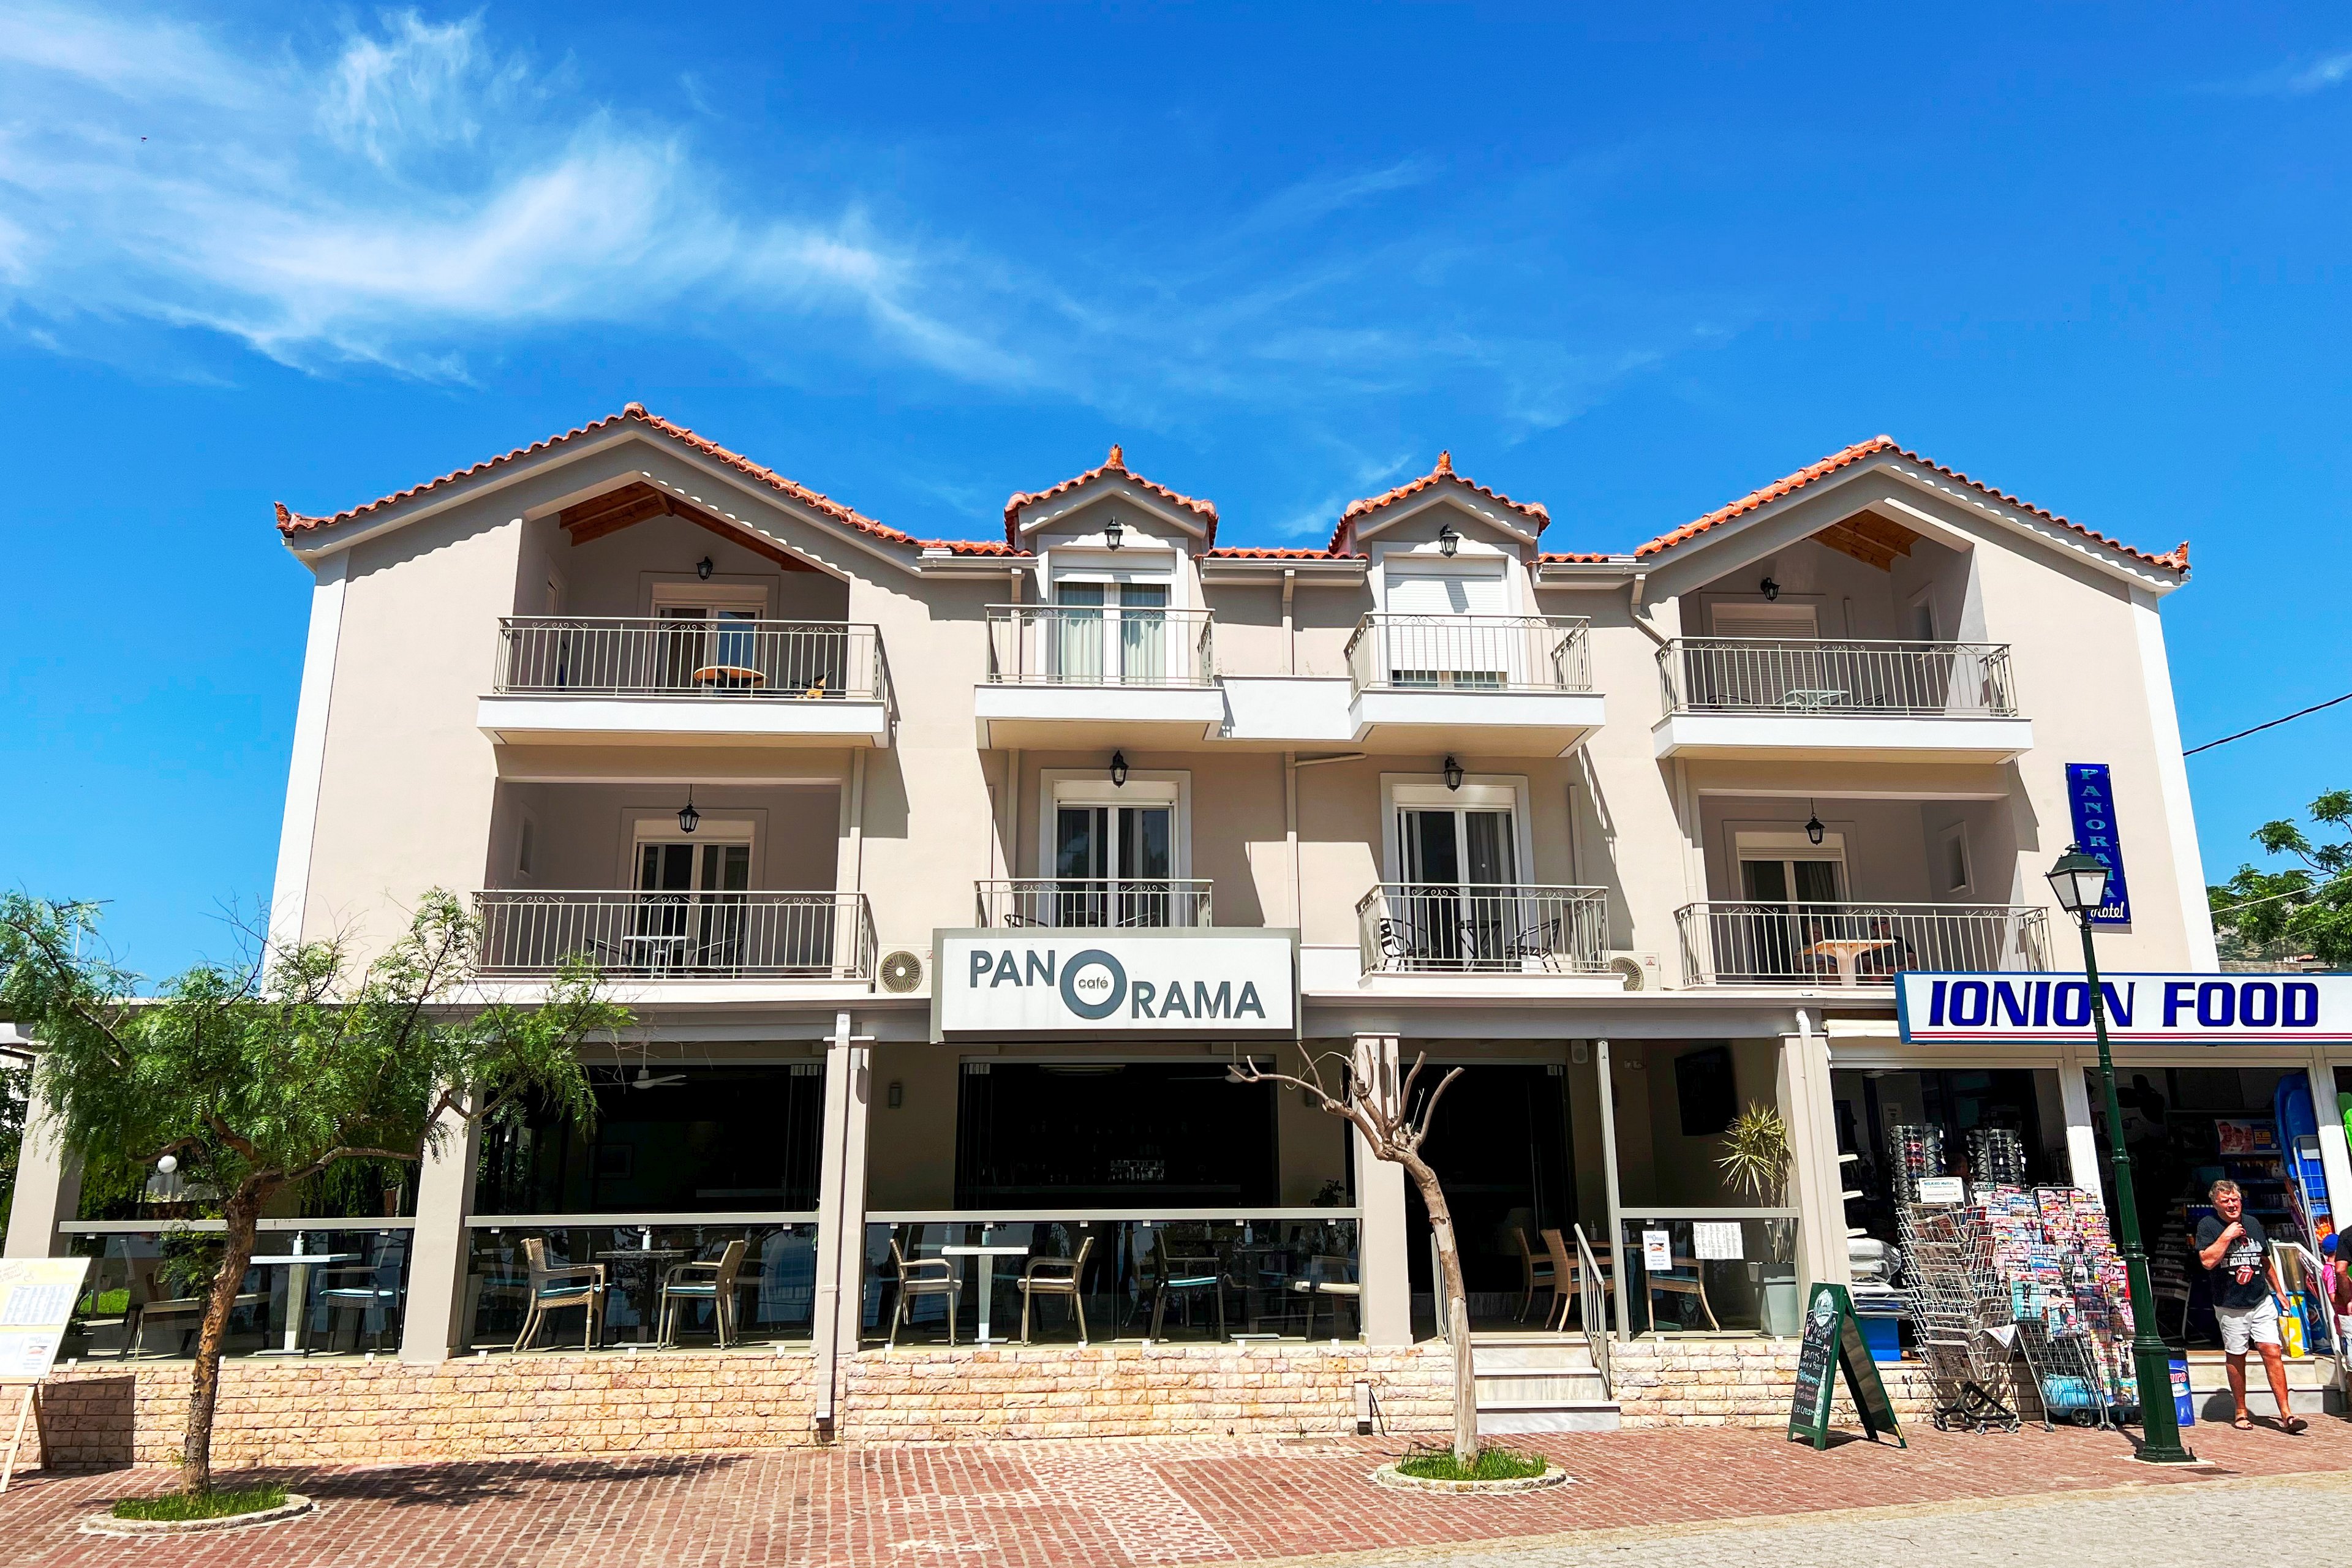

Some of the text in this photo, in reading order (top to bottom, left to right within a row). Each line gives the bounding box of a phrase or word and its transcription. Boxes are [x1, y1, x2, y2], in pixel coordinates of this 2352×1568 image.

[970, 948, 1266, 1019] PANORAMA
[1078, 976, 1109, 990] café
[1929, 981, 2318, 1027] IONION FOOD
[2170, 1373, 2187, 1384] ars
